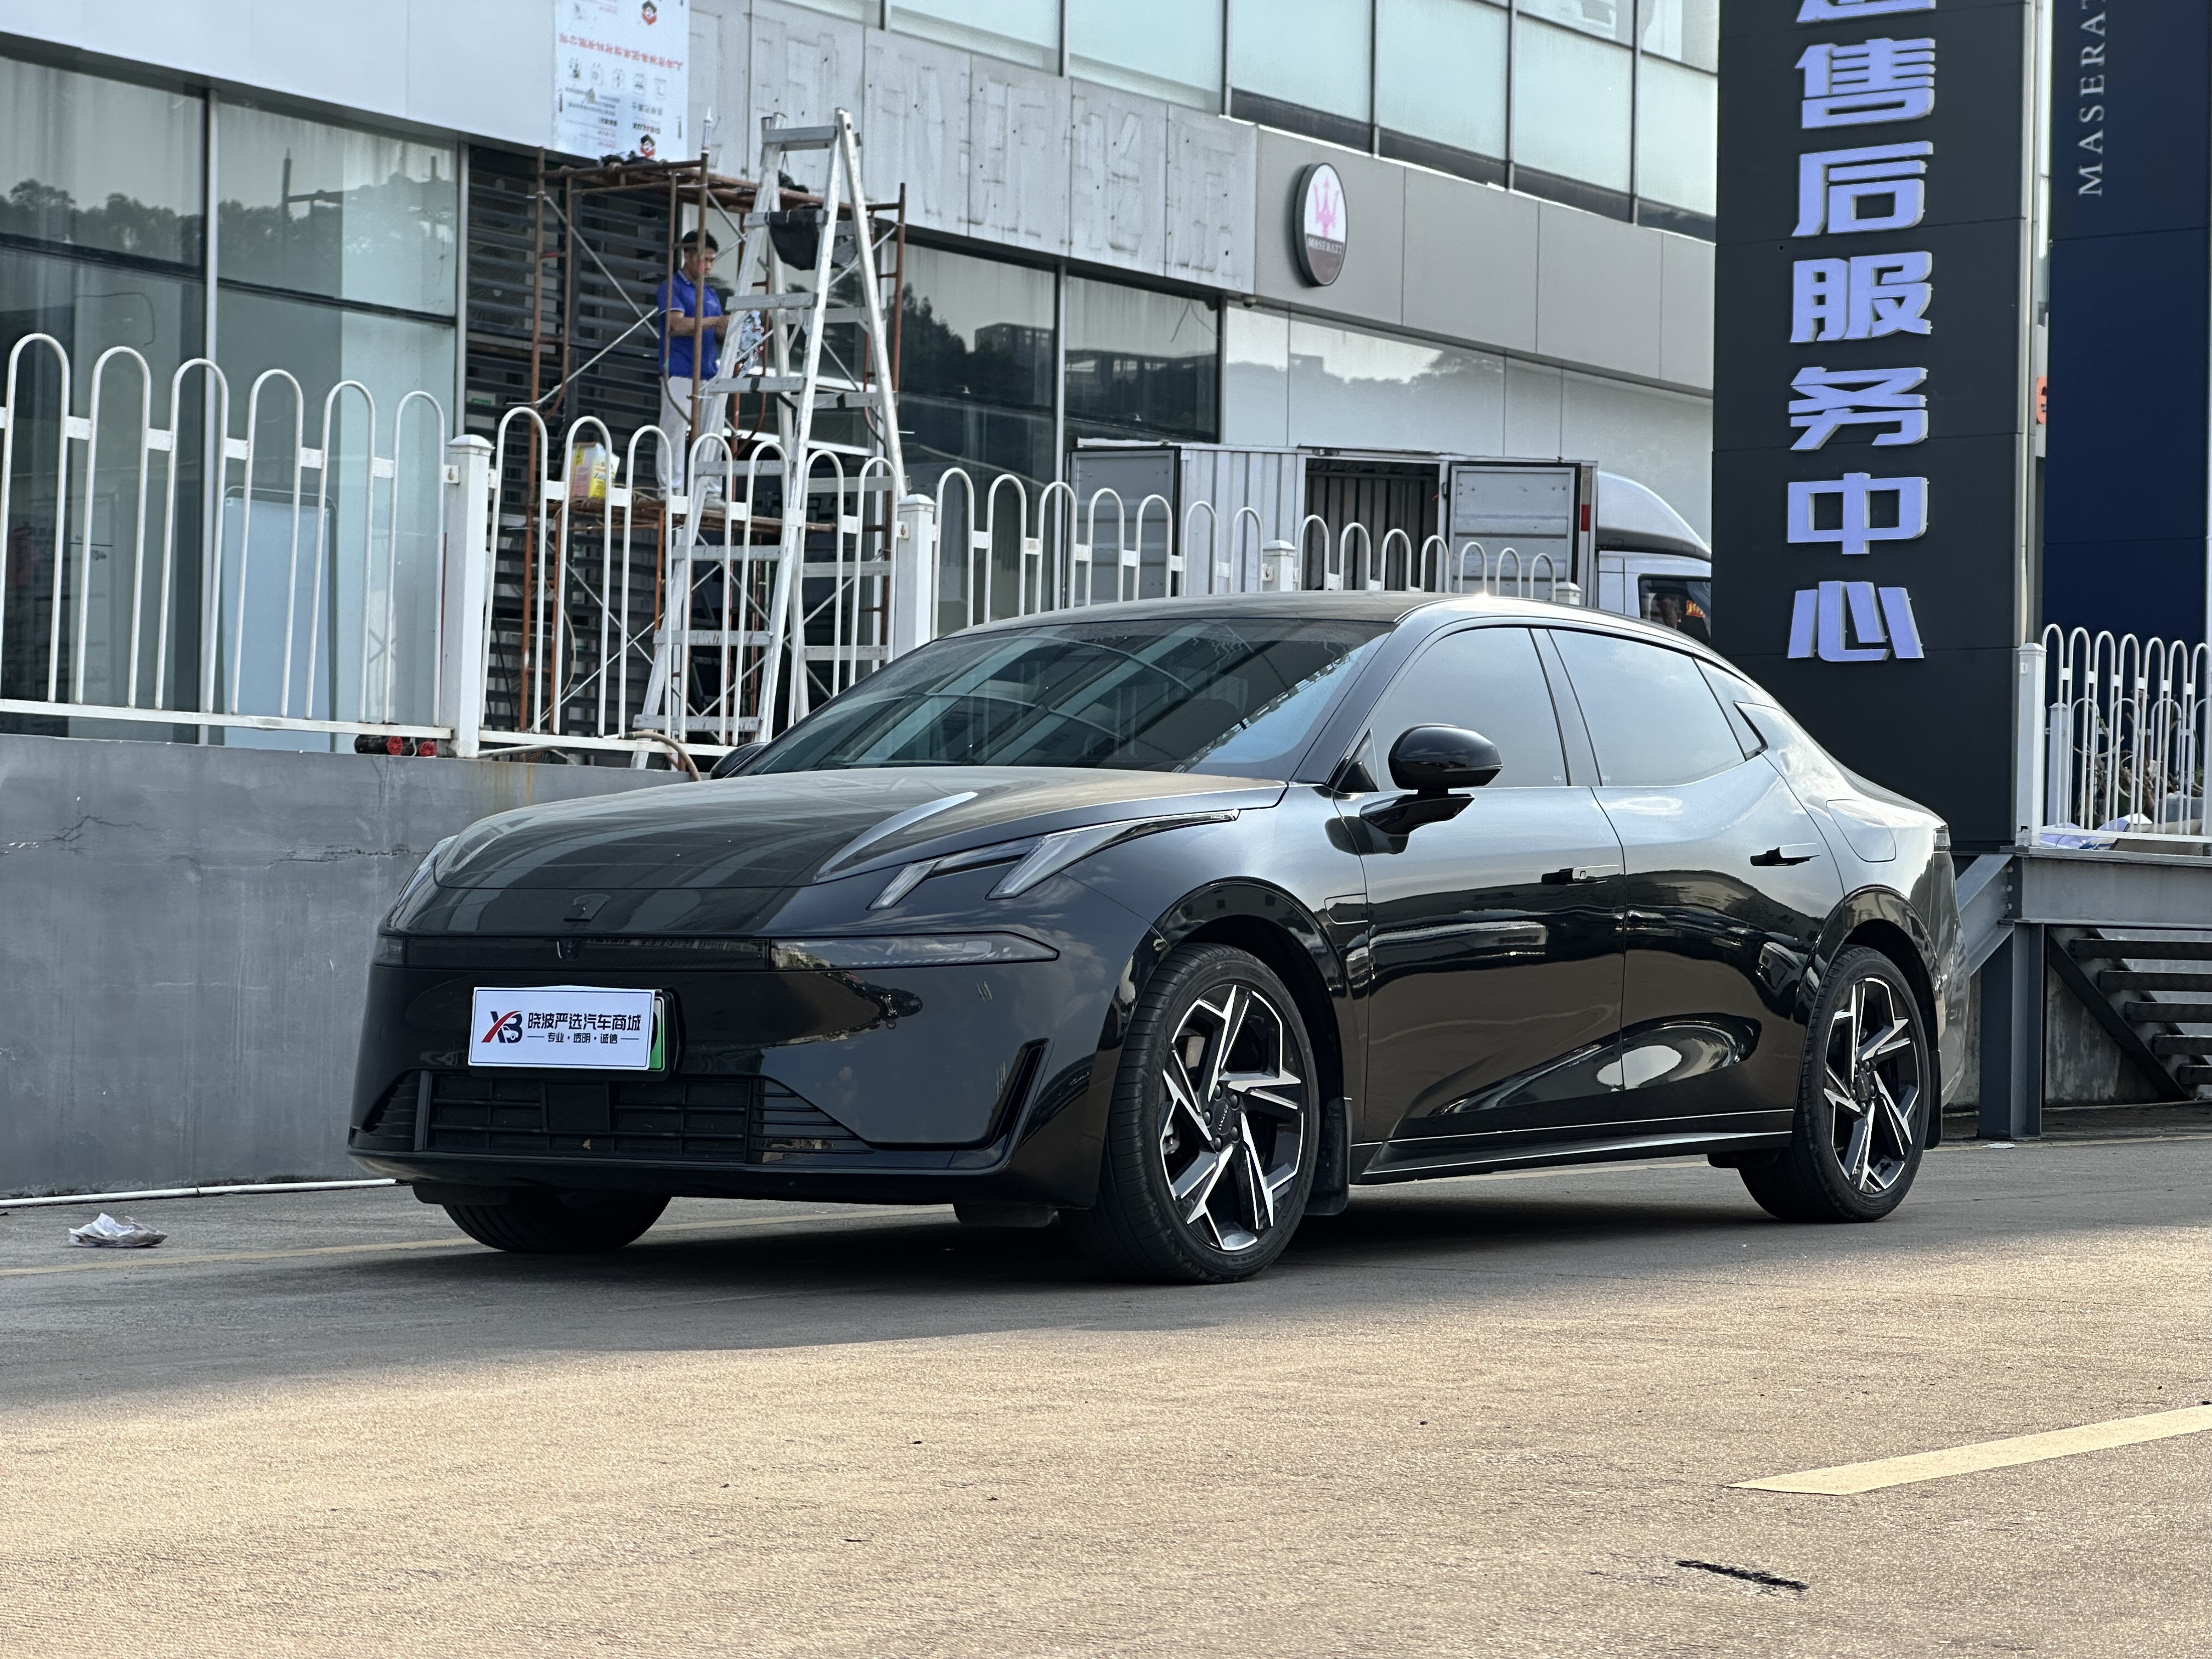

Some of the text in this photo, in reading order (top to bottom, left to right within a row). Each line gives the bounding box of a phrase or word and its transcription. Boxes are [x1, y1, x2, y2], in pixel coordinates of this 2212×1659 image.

[527, 1012, 641, 1031] 晓波严选汽车商城
